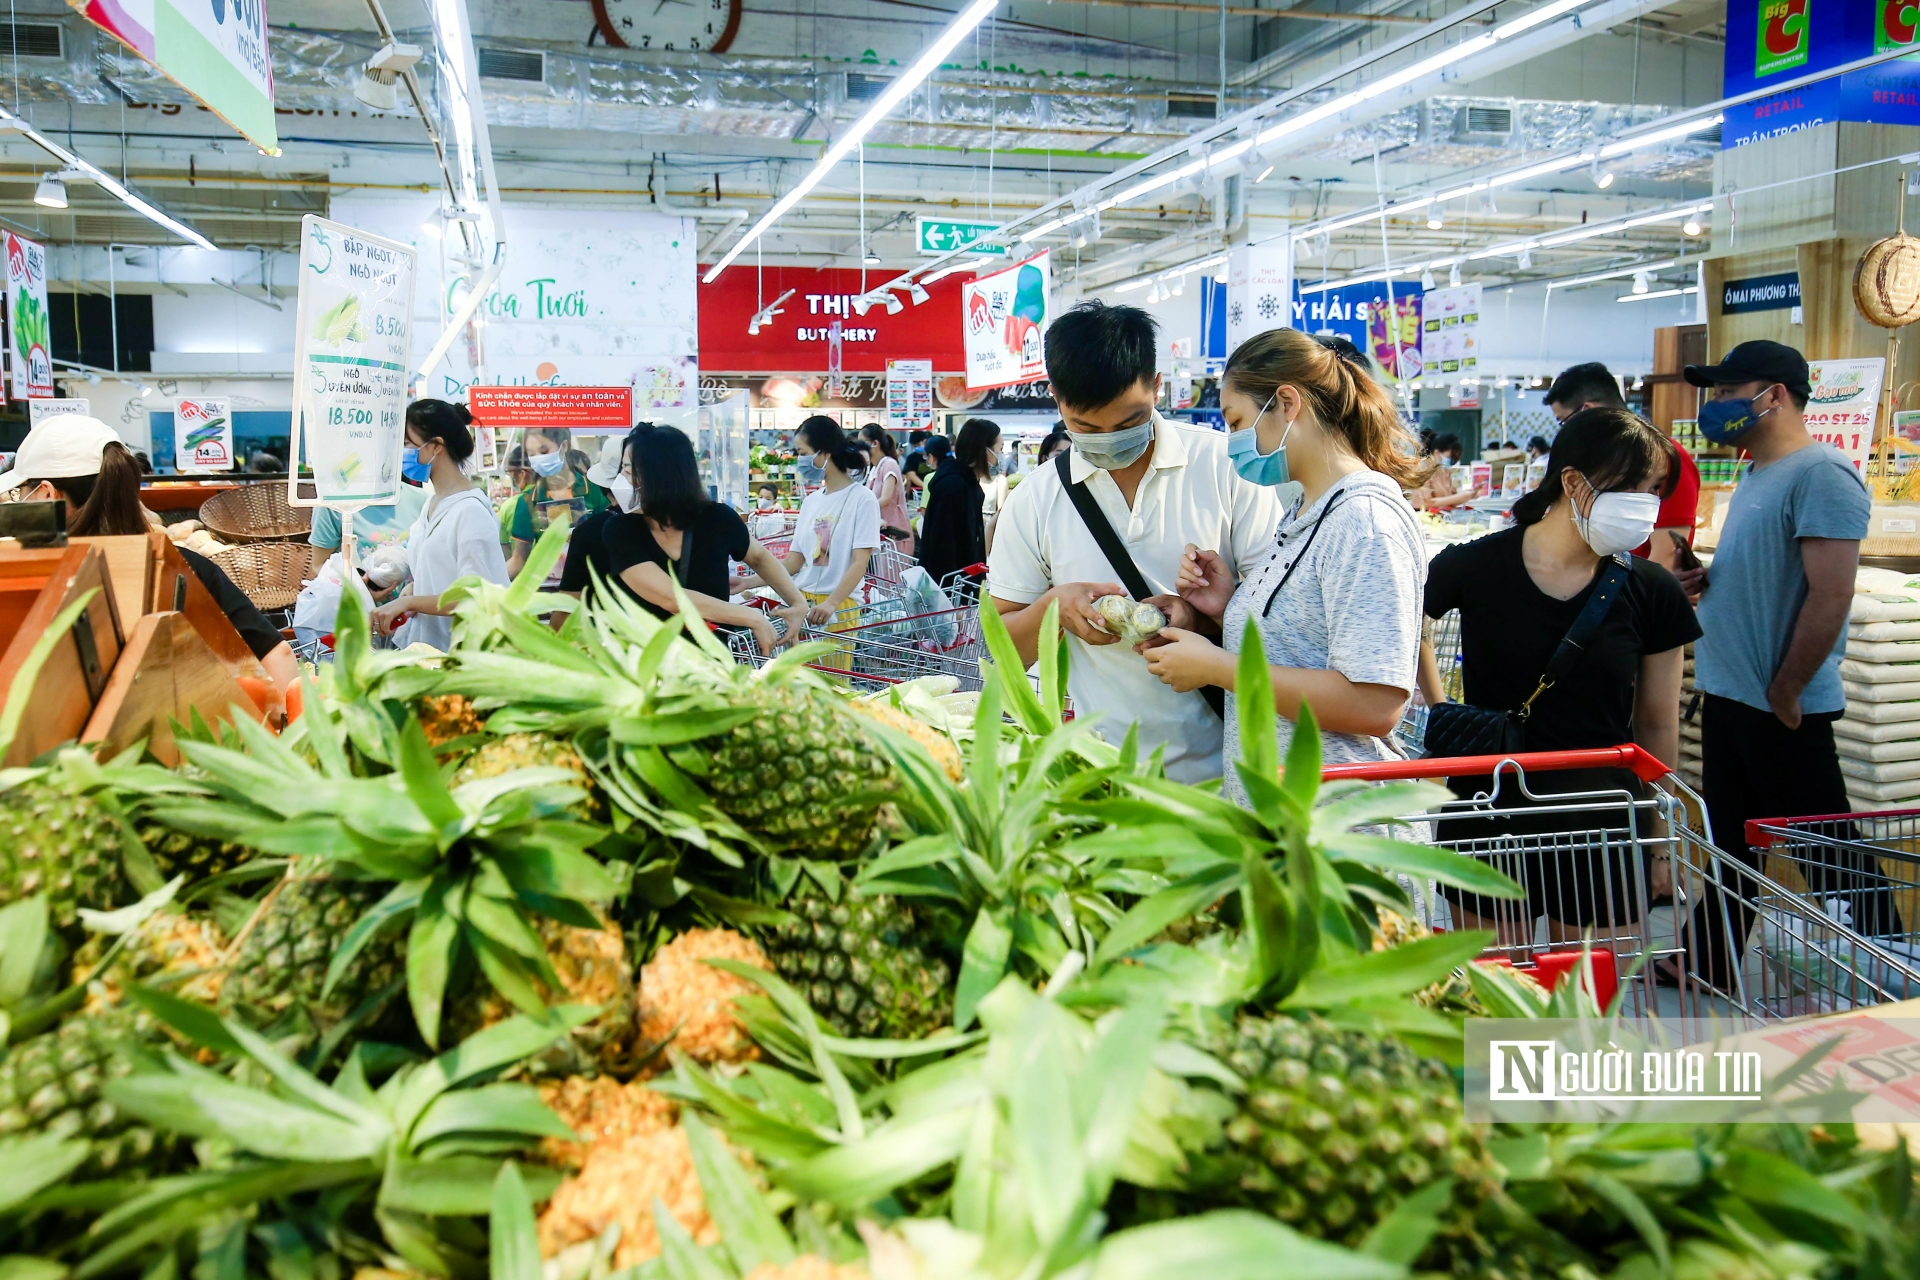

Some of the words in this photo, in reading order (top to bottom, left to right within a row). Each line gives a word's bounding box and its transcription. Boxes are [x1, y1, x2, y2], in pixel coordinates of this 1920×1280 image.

[1764, 3, 1789, 20] Big
[622, 16, 633, 29] 8
[703, 22, 713, 34] 4
[641, 35, 651, 48] 7
[690, 37, 700, 50] 5
[1758, 53, 1805, 72] SUPERCENTER
[1864, 73, 1919, 90] CENTRA
[1873, 90, 1919, 106] RETAIL
[1754, 97, 1805, 120] RETAIL
[349, 263, 371, 279] NGÔ
[526, 278, 588, 319] Tươi
[1749, 284, 1786, 302] PHƯƠNG
[1788, 283, 1801, 297] TH
[1311, 295, 1351, 320] HẢI
[797, 327, 877, 342] BUTHERY
[343, 368, 360, 379] NGÔ
[478, 399, 496, 407] sức
[498, 399, 520, 407] khỏe
[494, 391, 512, 399] chắn
[514, 392, 534, 400] được
[535, 391, 547, 400] lắp
[328, 407, 373, 425] 18.500
[1831, 414, 1850, 425] ST
[1852, 413, 1870, 425] 25
[1851, 434, 1860, 450] 1
